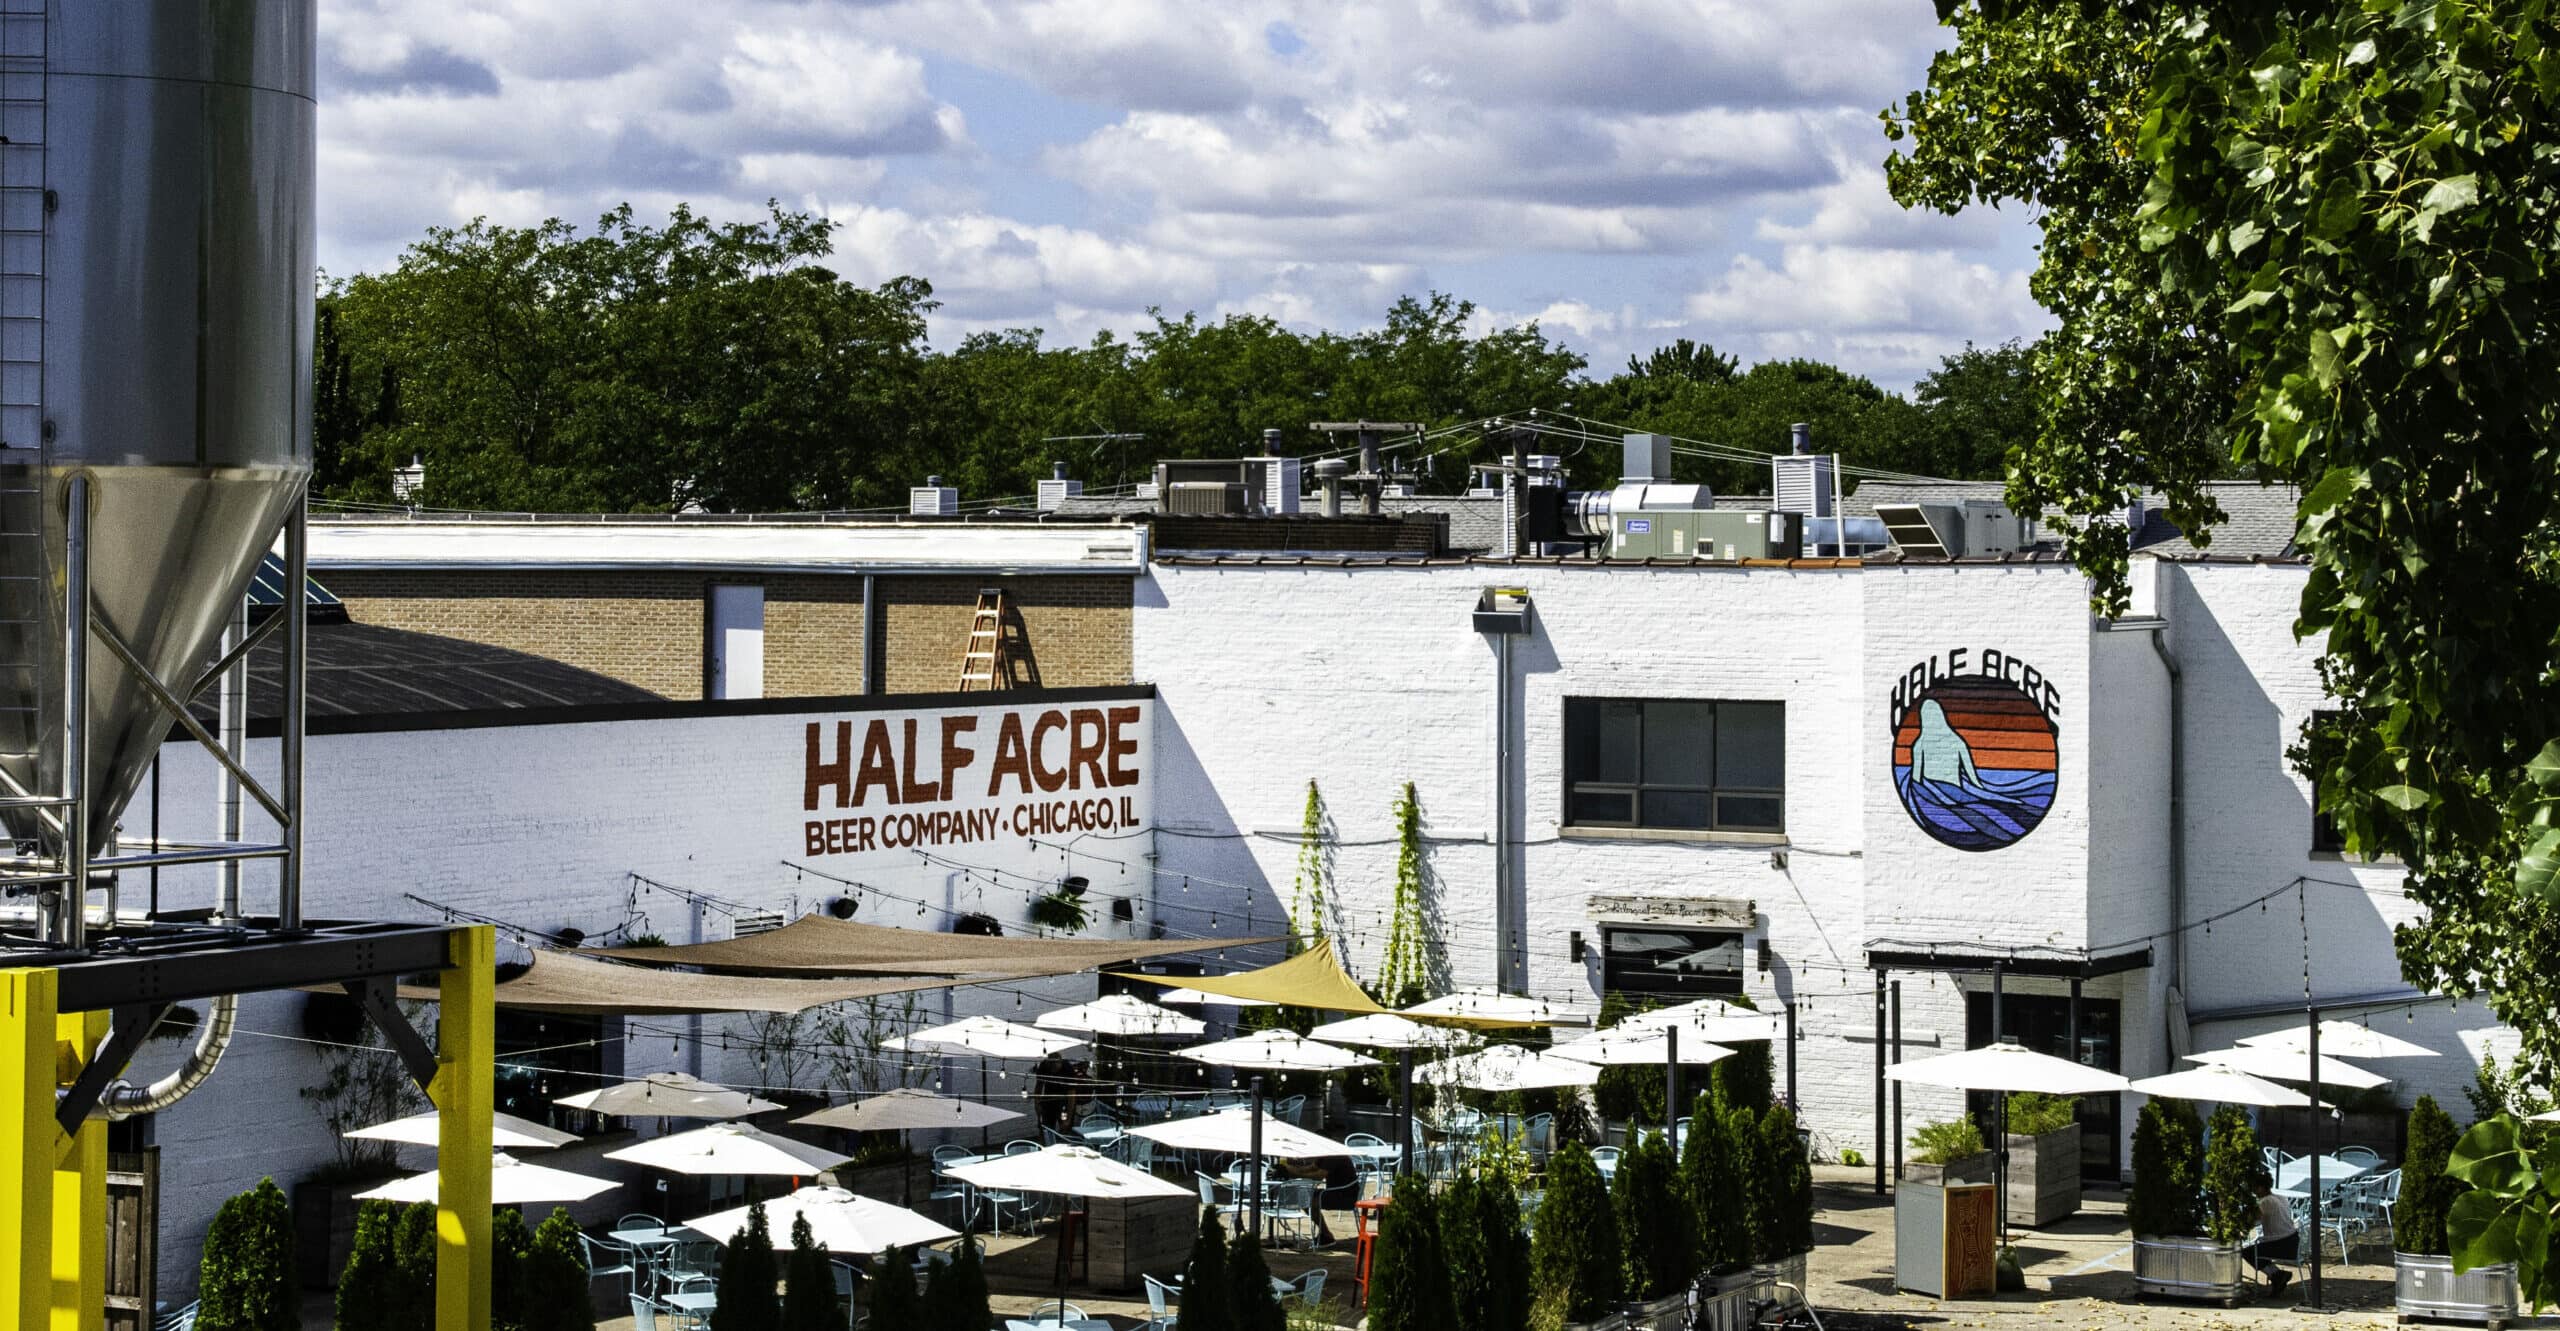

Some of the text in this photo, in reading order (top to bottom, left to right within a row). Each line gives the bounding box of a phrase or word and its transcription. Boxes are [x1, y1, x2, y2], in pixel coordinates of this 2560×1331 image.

[1890, 648, 2061, 738] HALF ACRE
[804, 706, 1140, 810] HALF ACRE
[805, 816, 876, 857] BEER
[881, 807, 1000, 847] COMPANY
